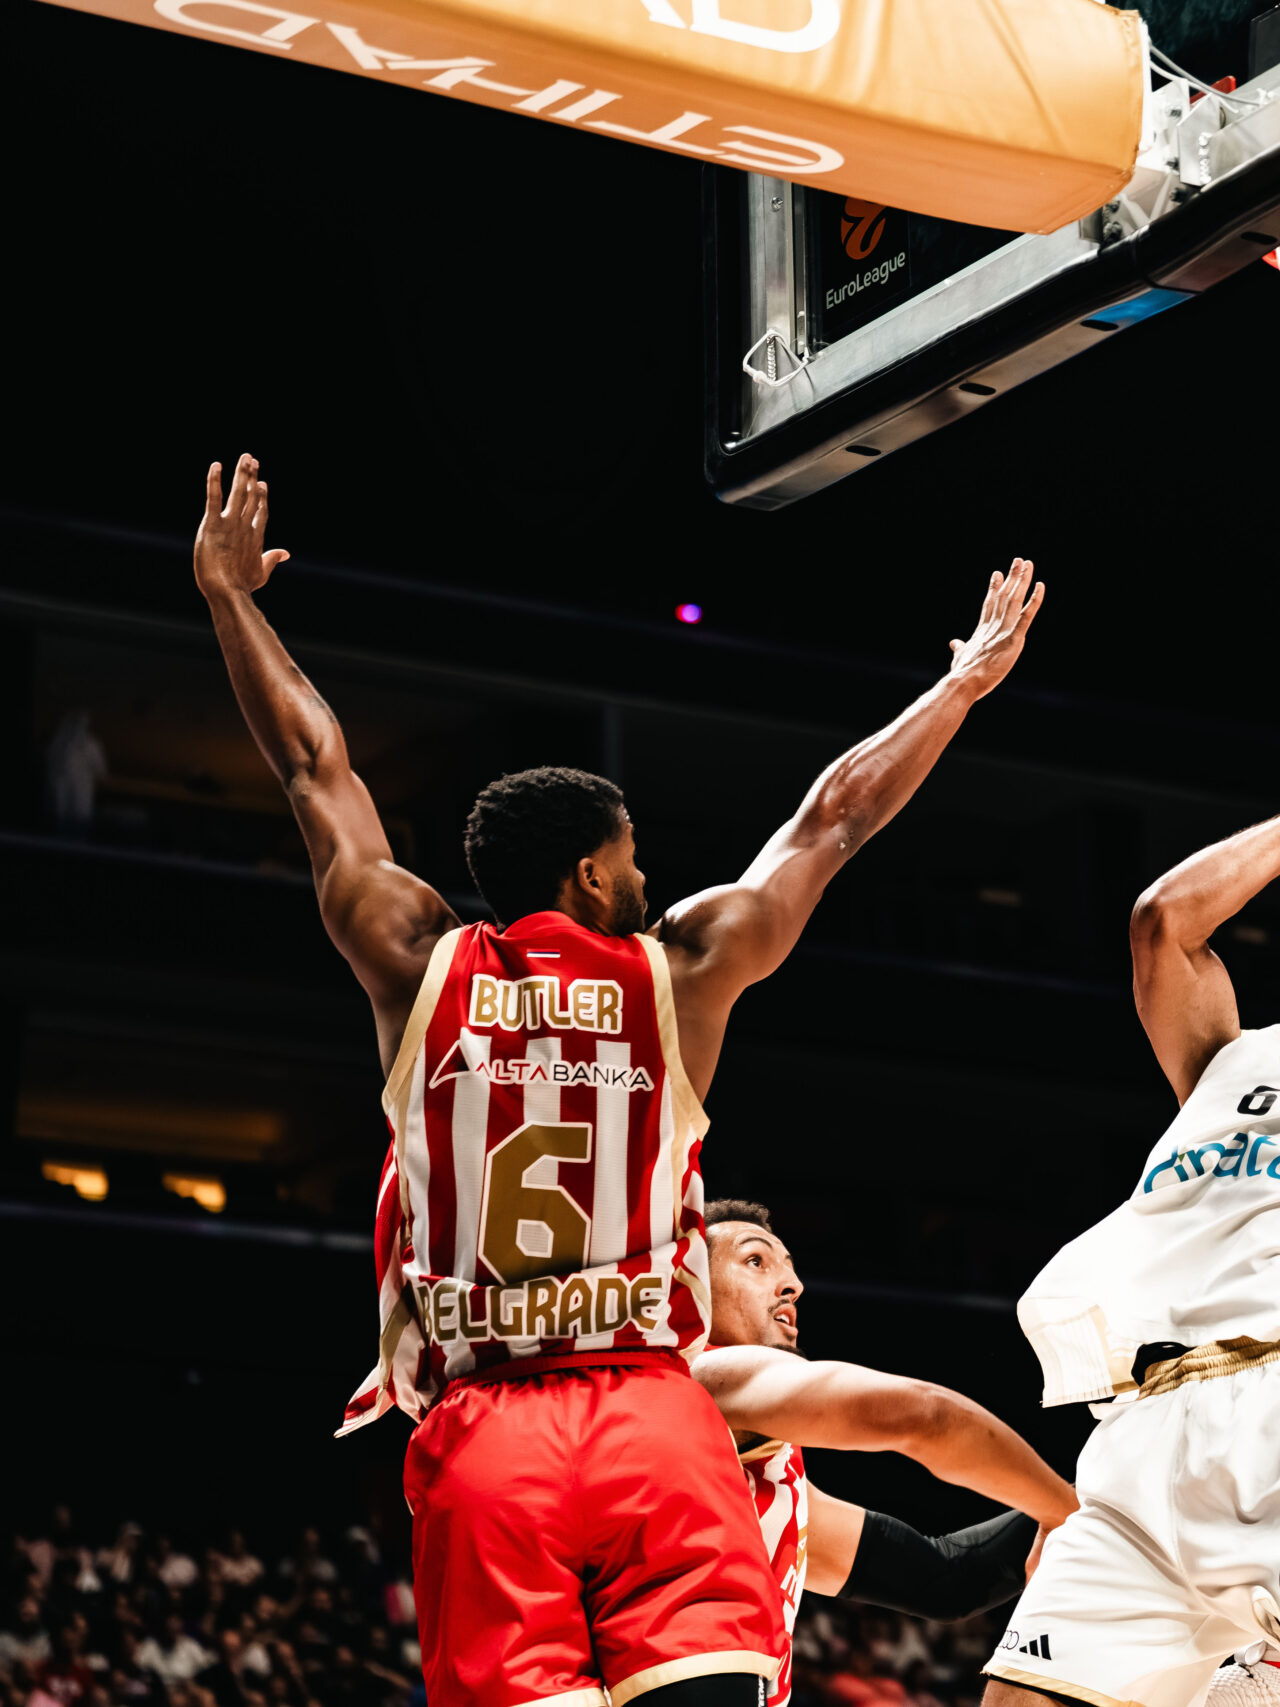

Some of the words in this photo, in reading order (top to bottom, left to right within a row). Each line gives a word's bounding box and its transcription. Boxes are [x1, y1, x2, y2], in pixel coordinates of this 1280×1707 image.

[153, 0, 845, 175] ETIHAD
[825, 251, 907, 311] EuroLeague
[470, 974, 623, 1034] BUTLER
[477, 1120, 593, 1287] 6
[415, 1273, 666, 1344] BELGRADE
